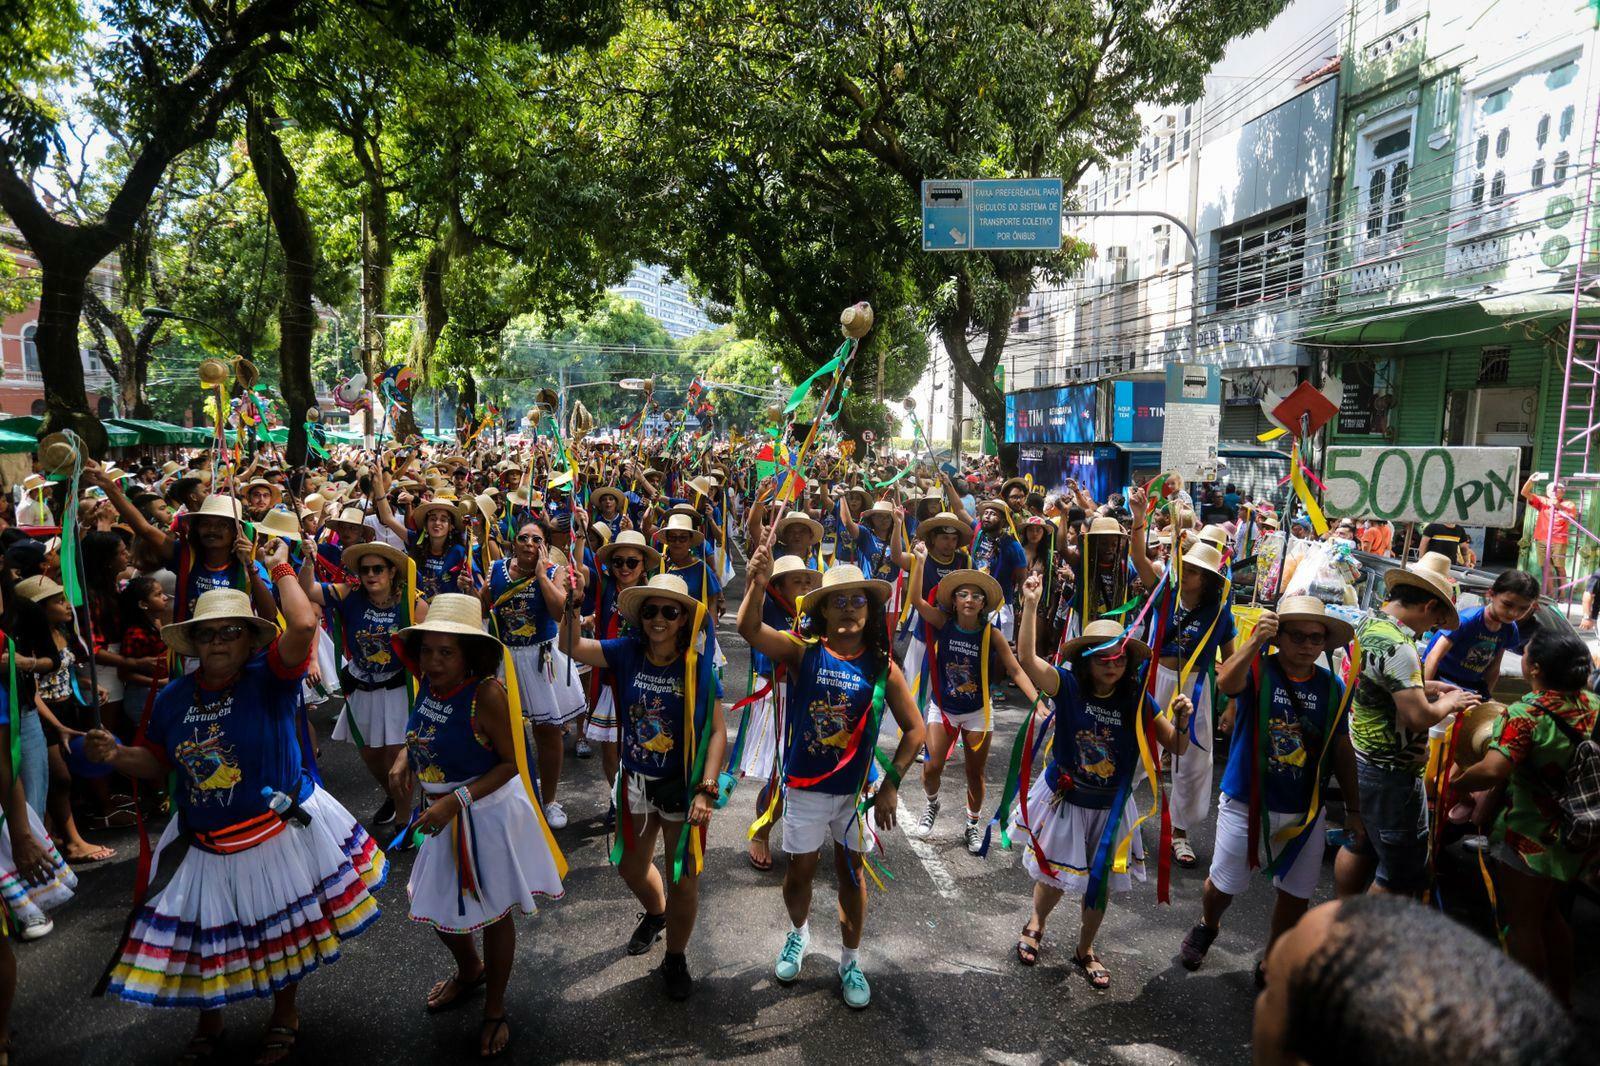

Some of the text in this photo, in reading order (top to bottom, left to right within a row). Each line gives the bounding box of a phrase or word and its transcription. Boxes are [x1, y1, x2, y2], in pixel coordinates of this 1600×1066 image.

[975, 186, 1060, 197] FAIXA PREFERÊNCIAL PARA
[975, 202, 1058, 211] VEÍCULOS DO SISTEMA DE
[979, 217, 1053, 226] TRANSPORTE COLETIVO
[997, 230, 1036, 241] POR ÔNIBUS
[1028, 408, 1044, 428] TIM
[1079, 450, 1094, 466] TIM
[817, 667, 861, 682] Arrastão do
[816, 676, 859, 691] Pavulagem
